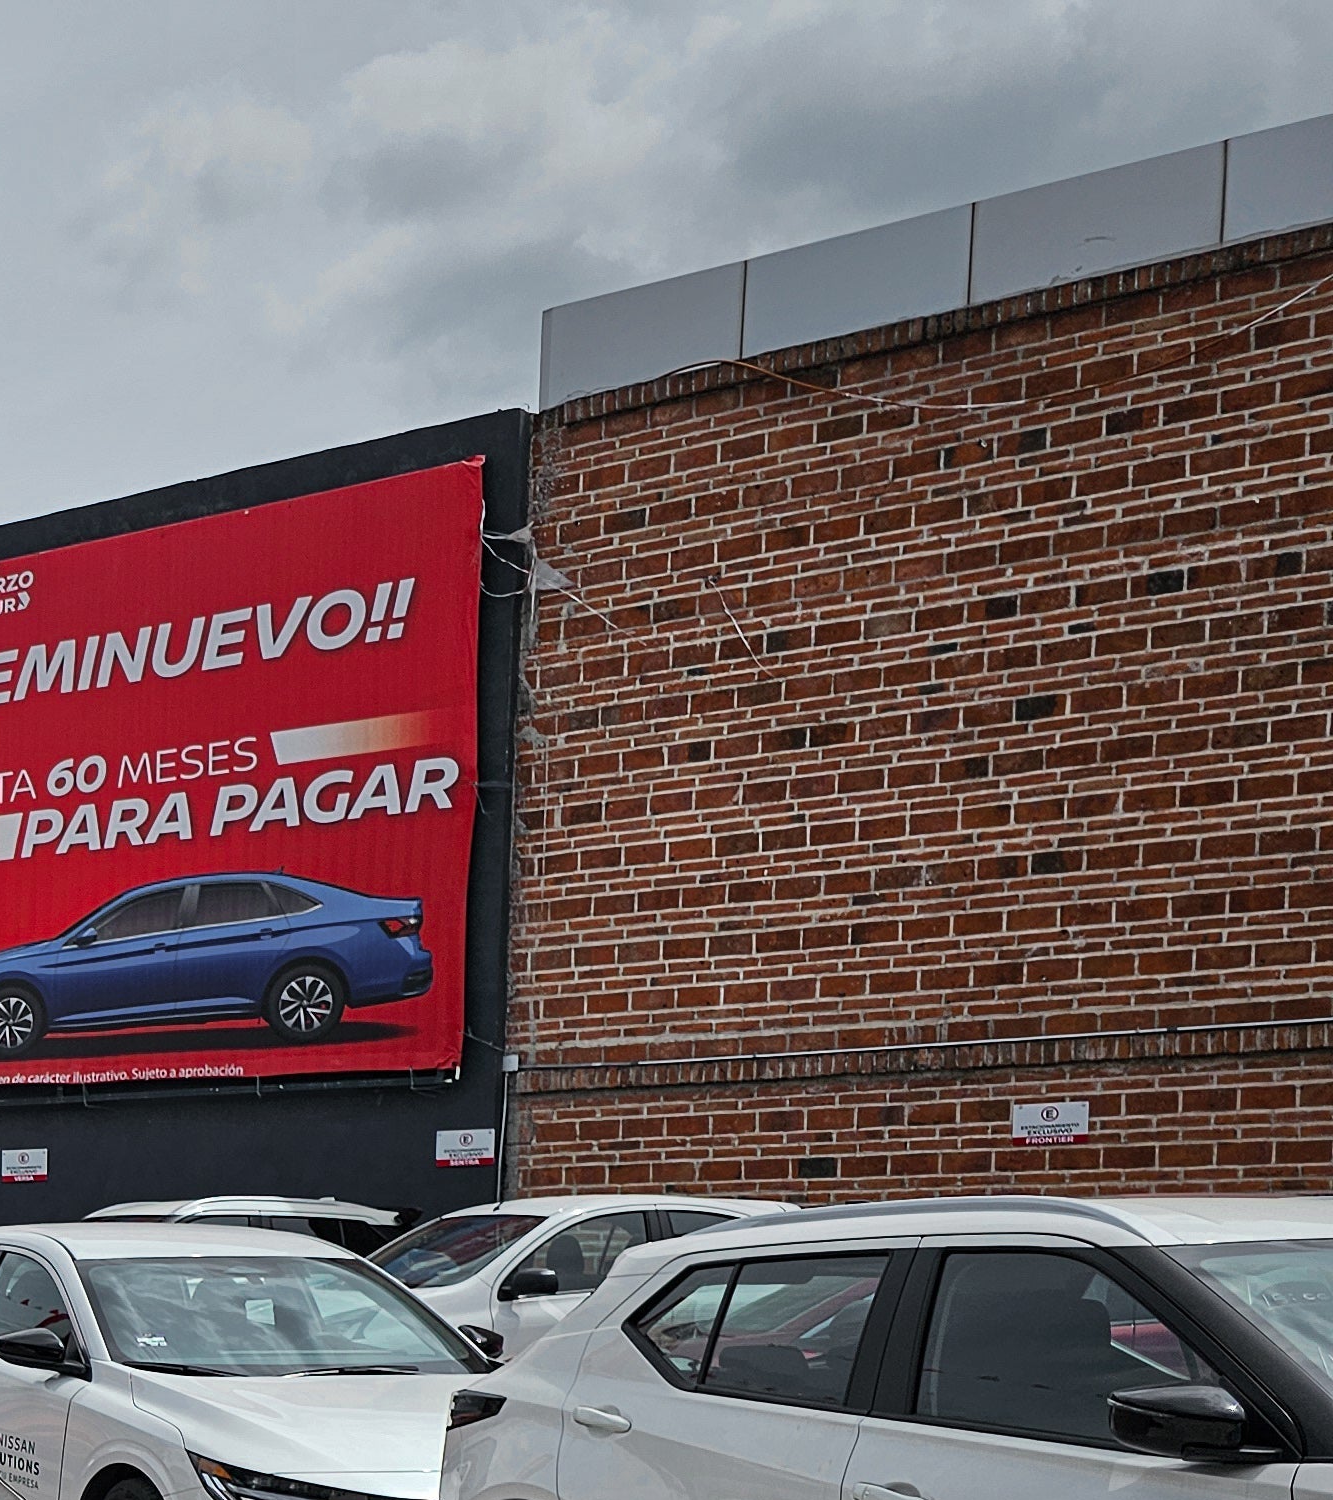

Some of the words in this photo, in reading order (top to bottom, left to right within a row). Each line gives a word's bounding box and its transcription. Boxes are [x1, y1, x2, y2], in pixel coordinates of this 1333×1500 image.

[46, 754, 107, 797] 60
[117, 736, 258, 789] MESES
[21, 791, 193, 859] PARA
[209, 756, 460, 837] PAGAR
[11, 1072, 26, 1085] de
[27, 1071, 71, 1084] carácter
[72, 1069, 130, 1084] ilustrativo.
[131, 1066, 168, 1081] Sujeto
[169, 1068, 177, 1078] a
[178, 1063, 244, 1079] aprobación
[1026, 1135, 1074, 1145] FRONTIER
